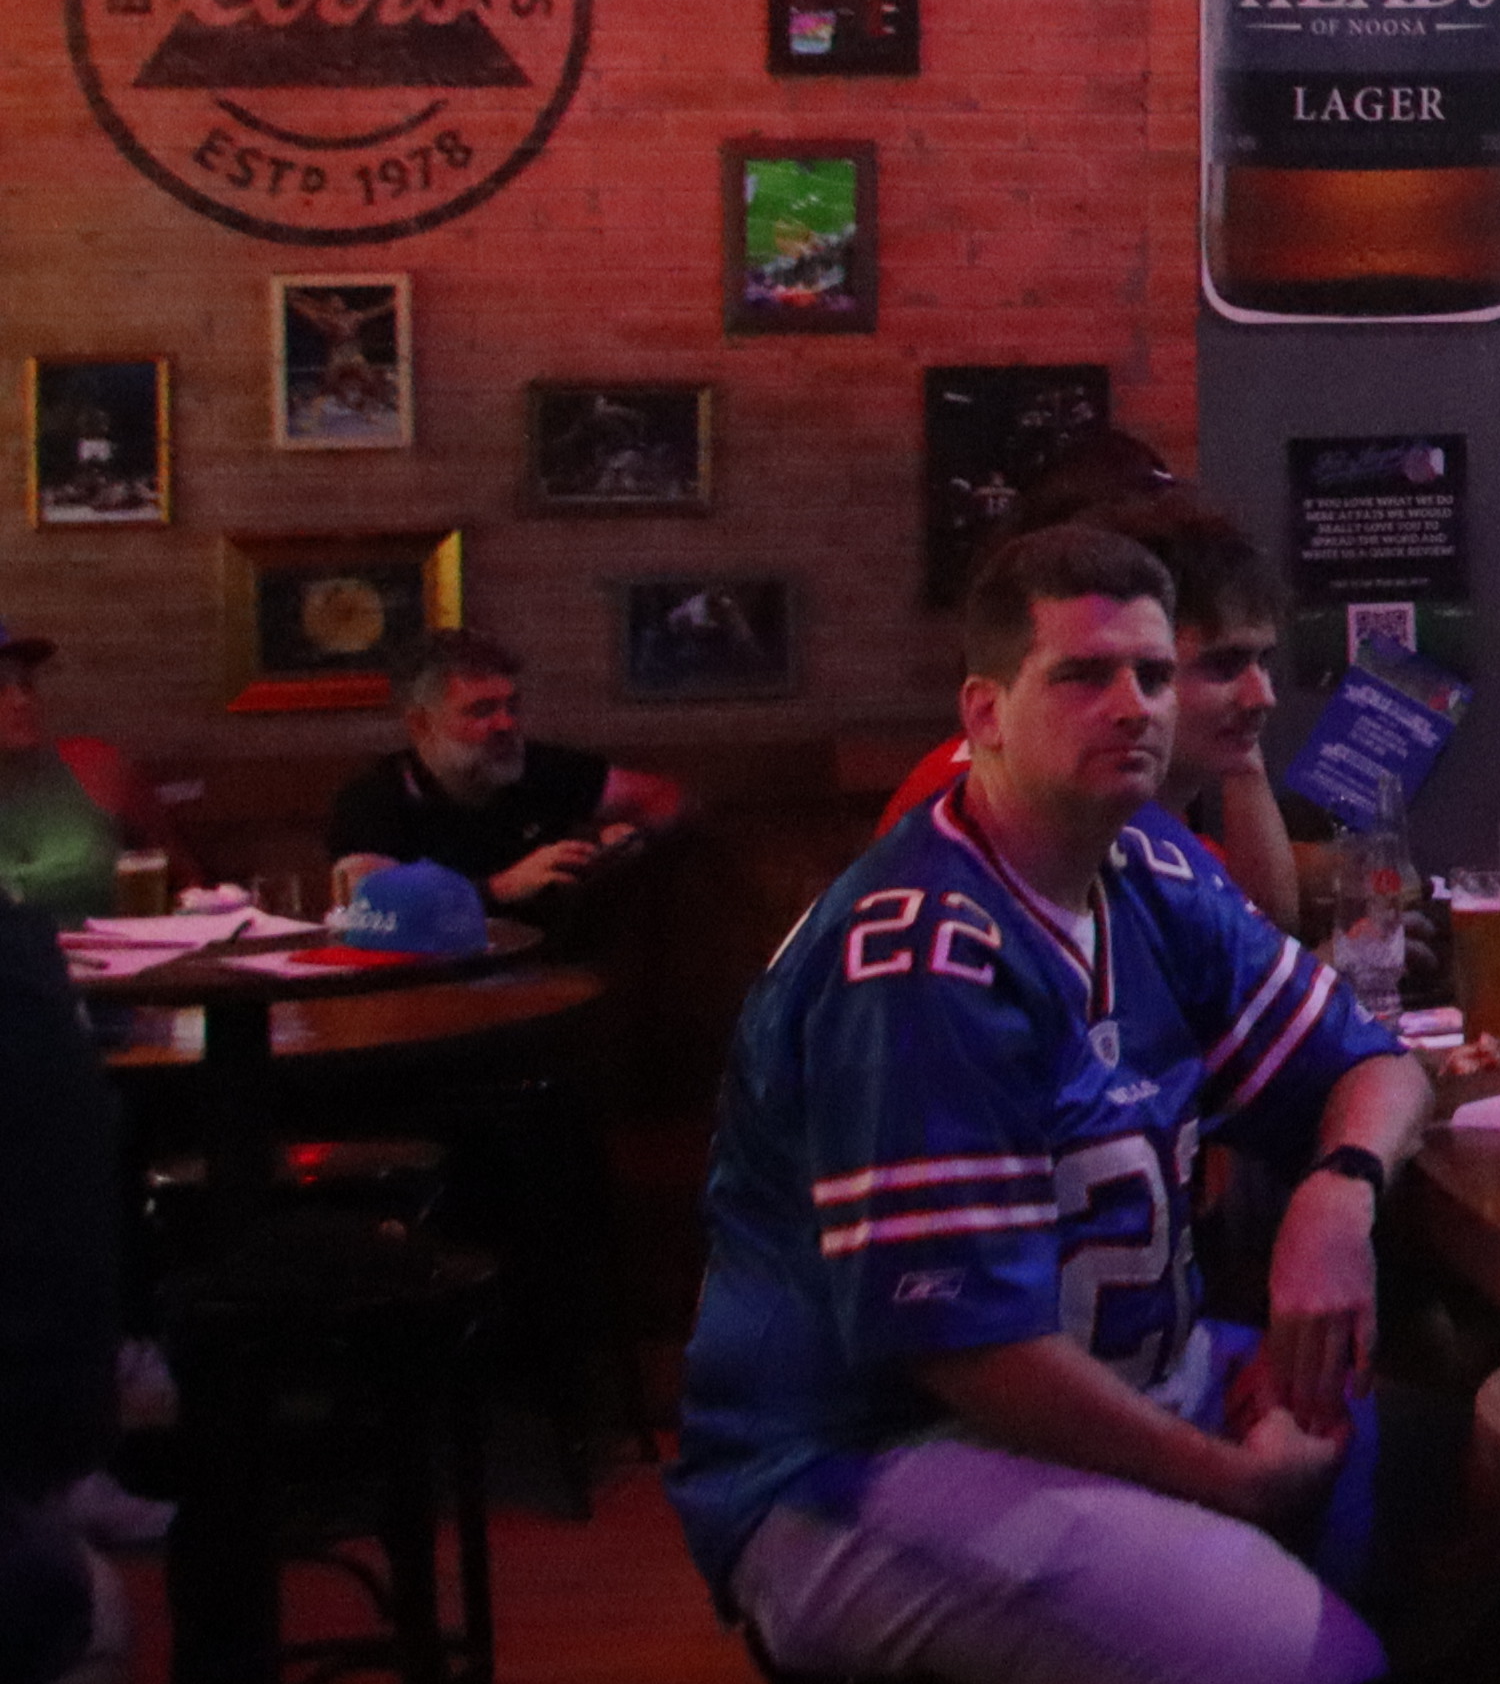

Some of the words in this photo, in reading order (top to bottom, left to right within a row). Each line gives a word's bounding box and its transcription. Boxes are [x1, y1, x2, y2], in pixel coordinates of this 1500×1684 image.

[1310, 18, 1340, 37] OF
[1348, 18, 1428, 38] NOOSA
[1292, 85, 1447, 123] LAGER
[353, 128, 474, 206] 1978
[1344, 496, 1374, 508] LOVE
[1376, 495, 1413, 508] WHAT
[1436, 494, 1455, 506] DO
[1407, 507, 1454, 519] WOULD
[1382, 533, 1419, 545] WORD
[1419, 532, 1449, 544] AND
[842, 886, 1001, 989] 22
